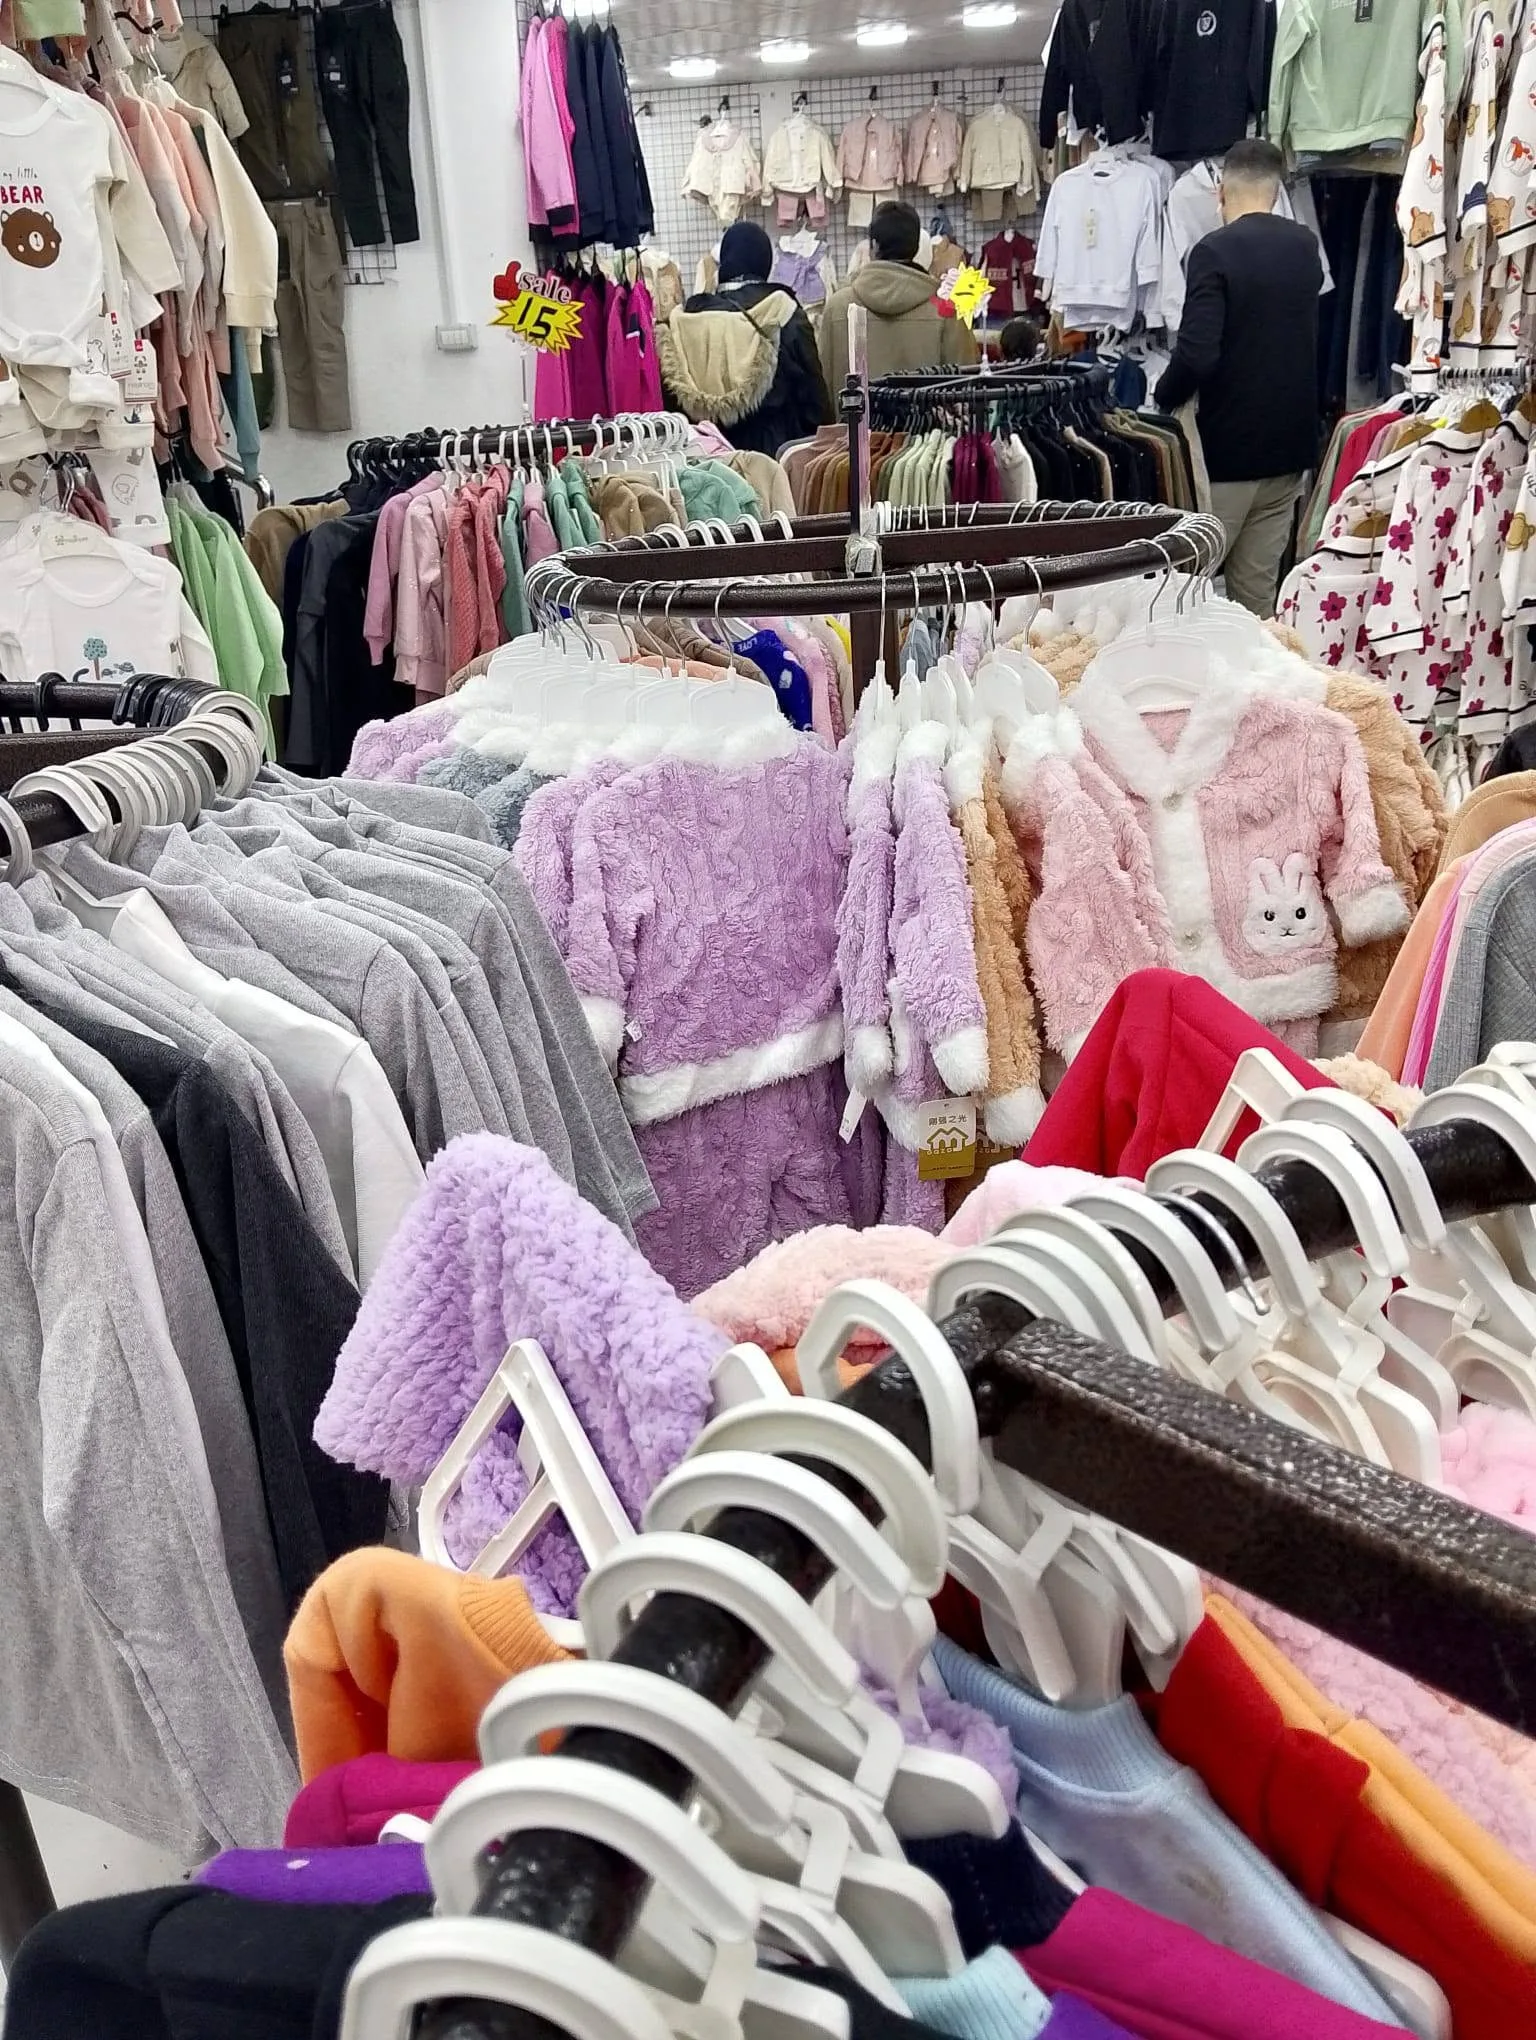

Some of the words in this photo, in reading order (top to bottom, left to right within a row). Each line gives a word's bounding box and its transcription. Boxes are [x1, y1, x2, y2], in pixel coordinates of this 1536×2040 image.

[0, 185, 45, 204] BEAR
[519, 272, 572, 304] sale
[517, 297, 558, 339] 15
